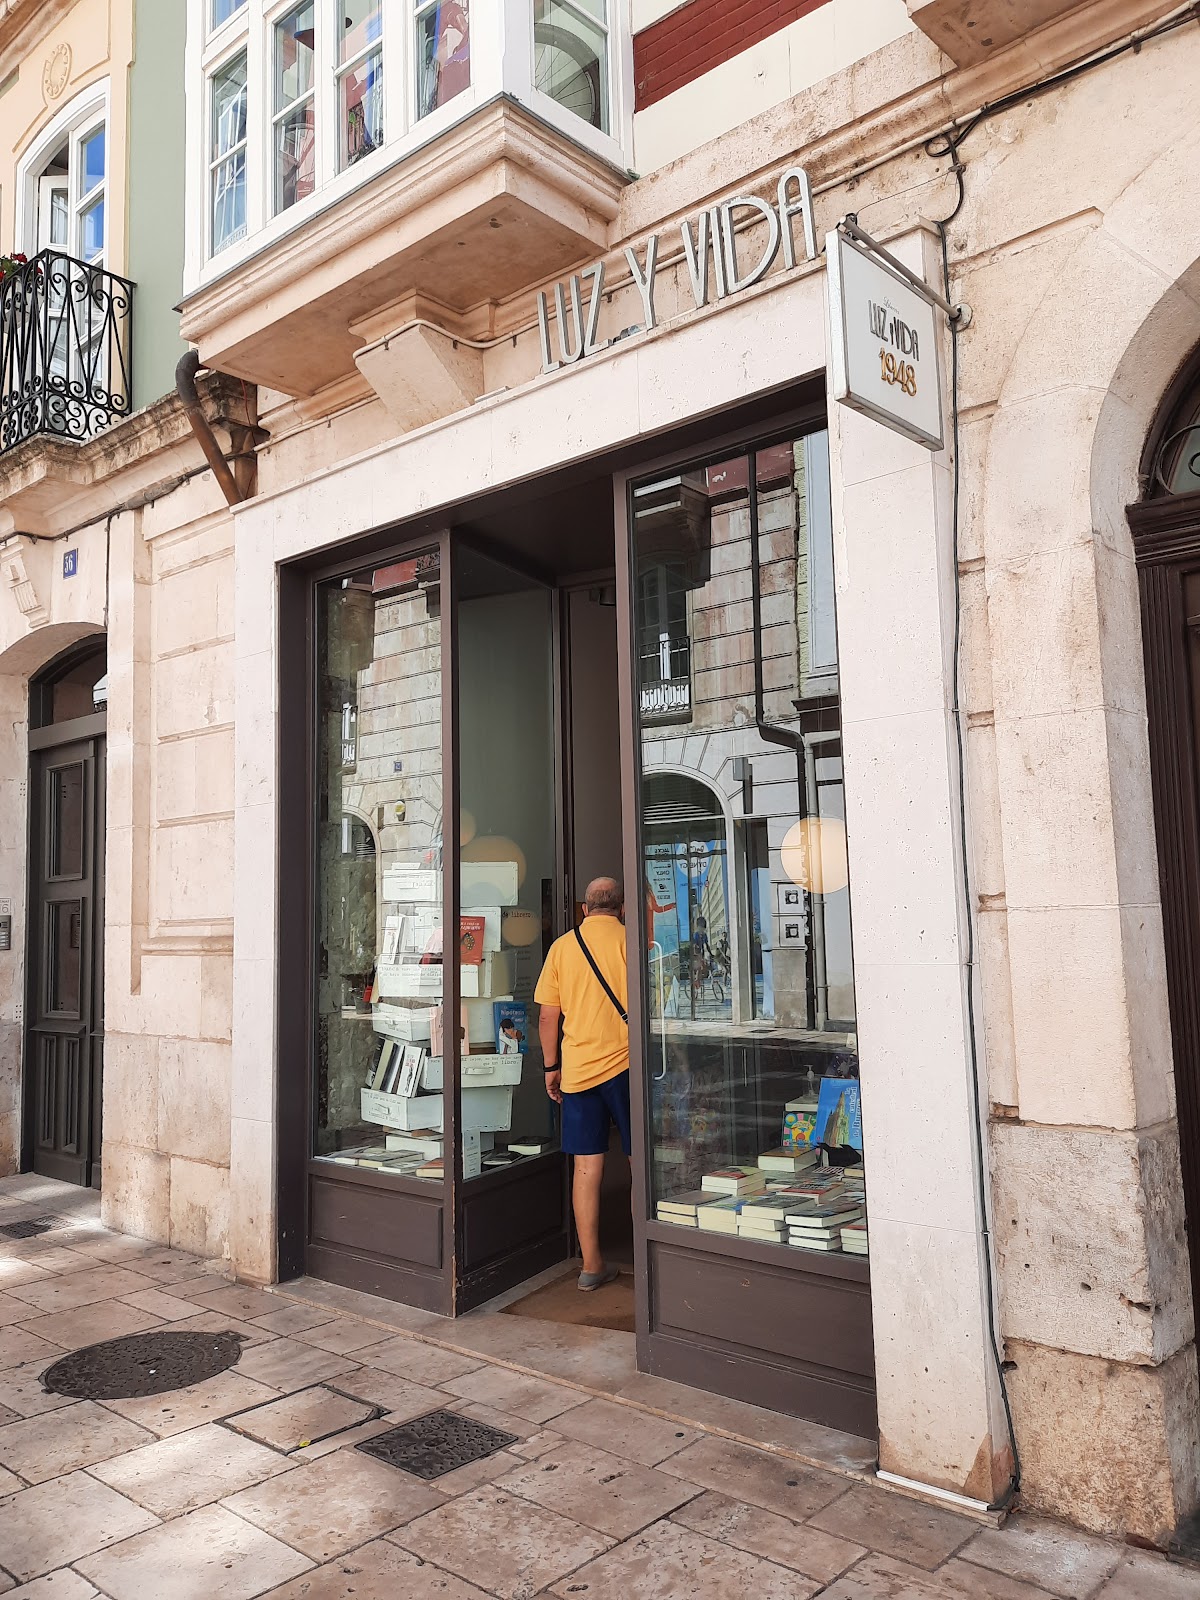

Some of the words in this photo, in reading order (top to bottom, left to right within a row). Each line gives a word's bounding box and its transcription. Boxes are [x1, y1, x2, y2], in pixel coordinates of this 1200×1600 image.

[536, 261, 610, 374] LUZ
[624, 234, 659, 330] Y
[681, 167, 818, 308] VIDA
[868, 299, 888, 342] LUZ
[893, 316, 920, 361] VIDA
[878, 346, 917, 396] 1948
[64, 553, 73, 573] 36
